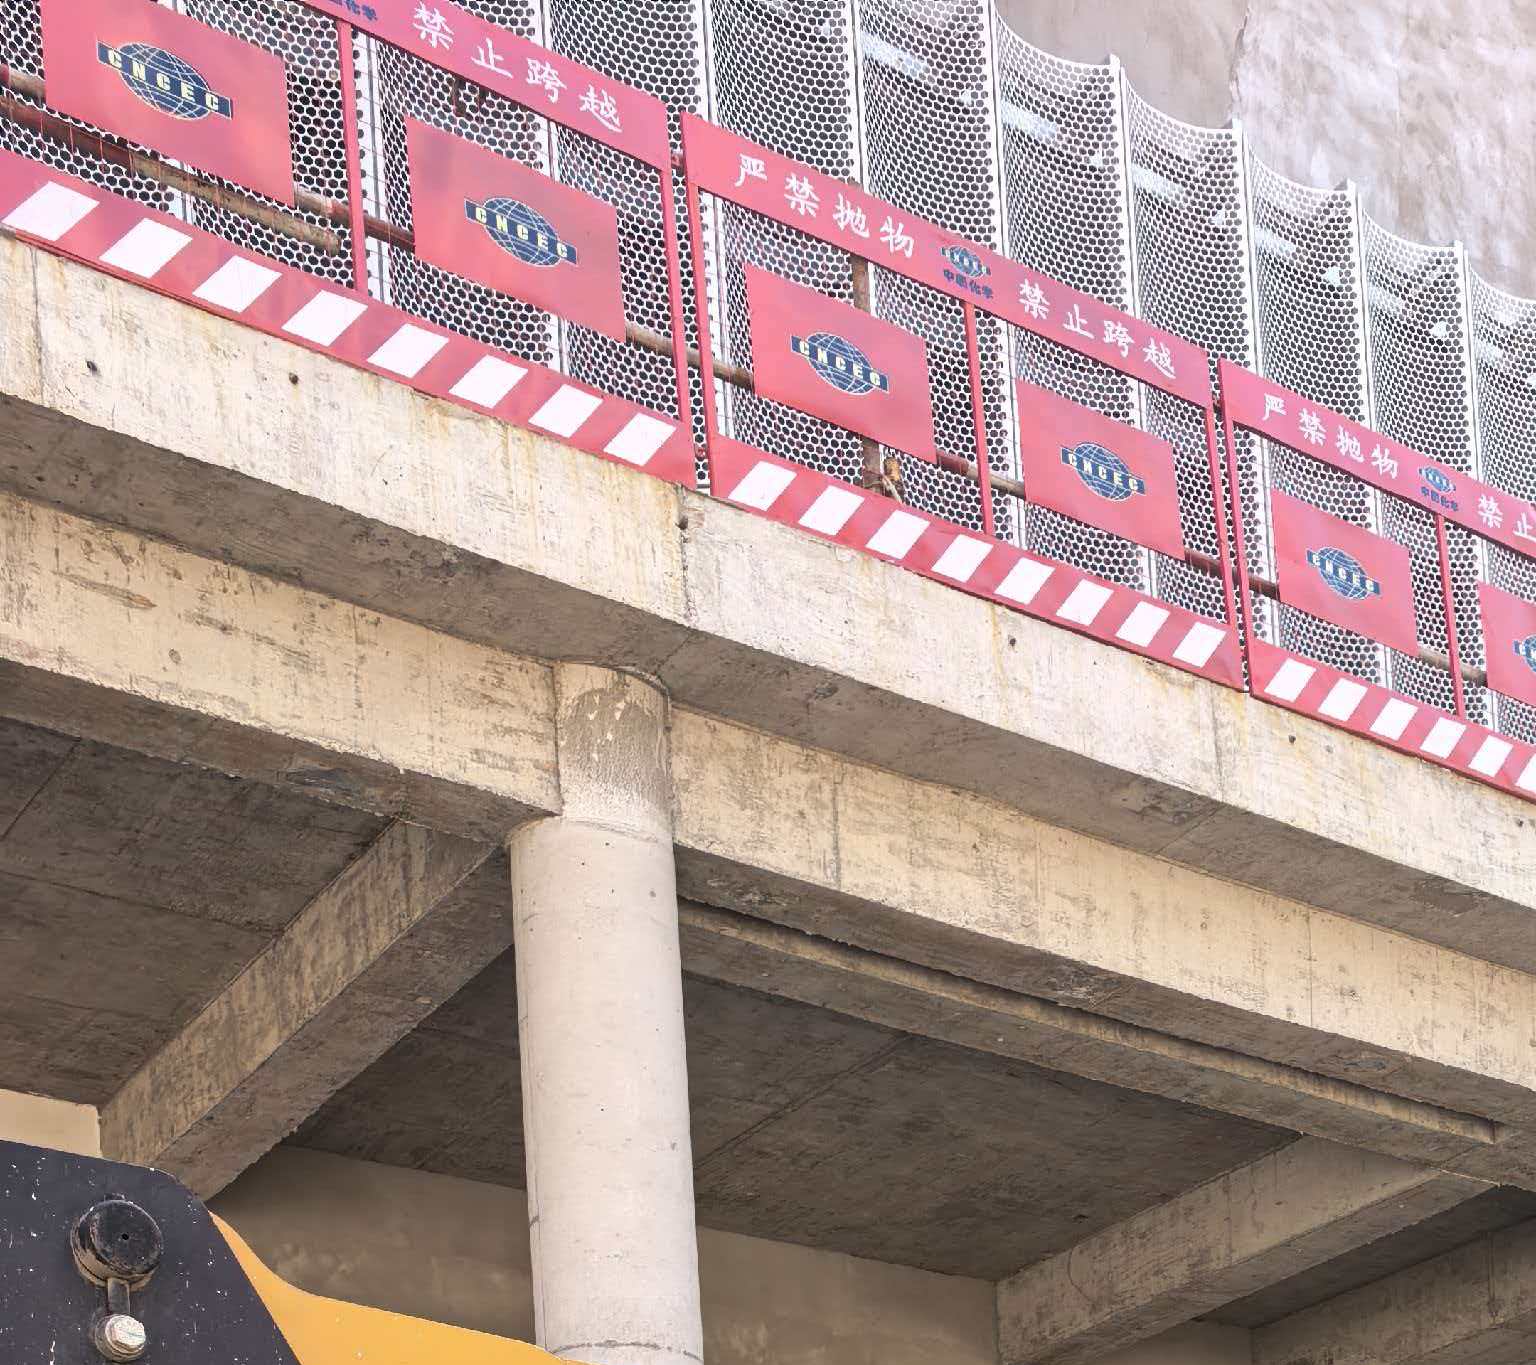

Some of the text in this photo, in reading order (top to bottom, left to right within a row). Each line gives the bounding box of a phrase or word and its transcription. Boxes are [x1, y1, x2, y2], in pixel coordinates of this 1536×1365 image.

[107, 46, 222, 114] CNCEC
[412, 2, 623, 134] 禁止跨越
[474, 205, 571, 261] CNCEC
[735, 152, 915, 259] 严禁抛物
[798, 338, 886, 388] CNCEC
[1018, 278, 1177, 380] 禁止跨越
[1261, 392, 1399, 480] 严禁抛物
[1067, 450, 1142, 493] CNCEC
[1313, 550, 1377, 594] CNCEC
